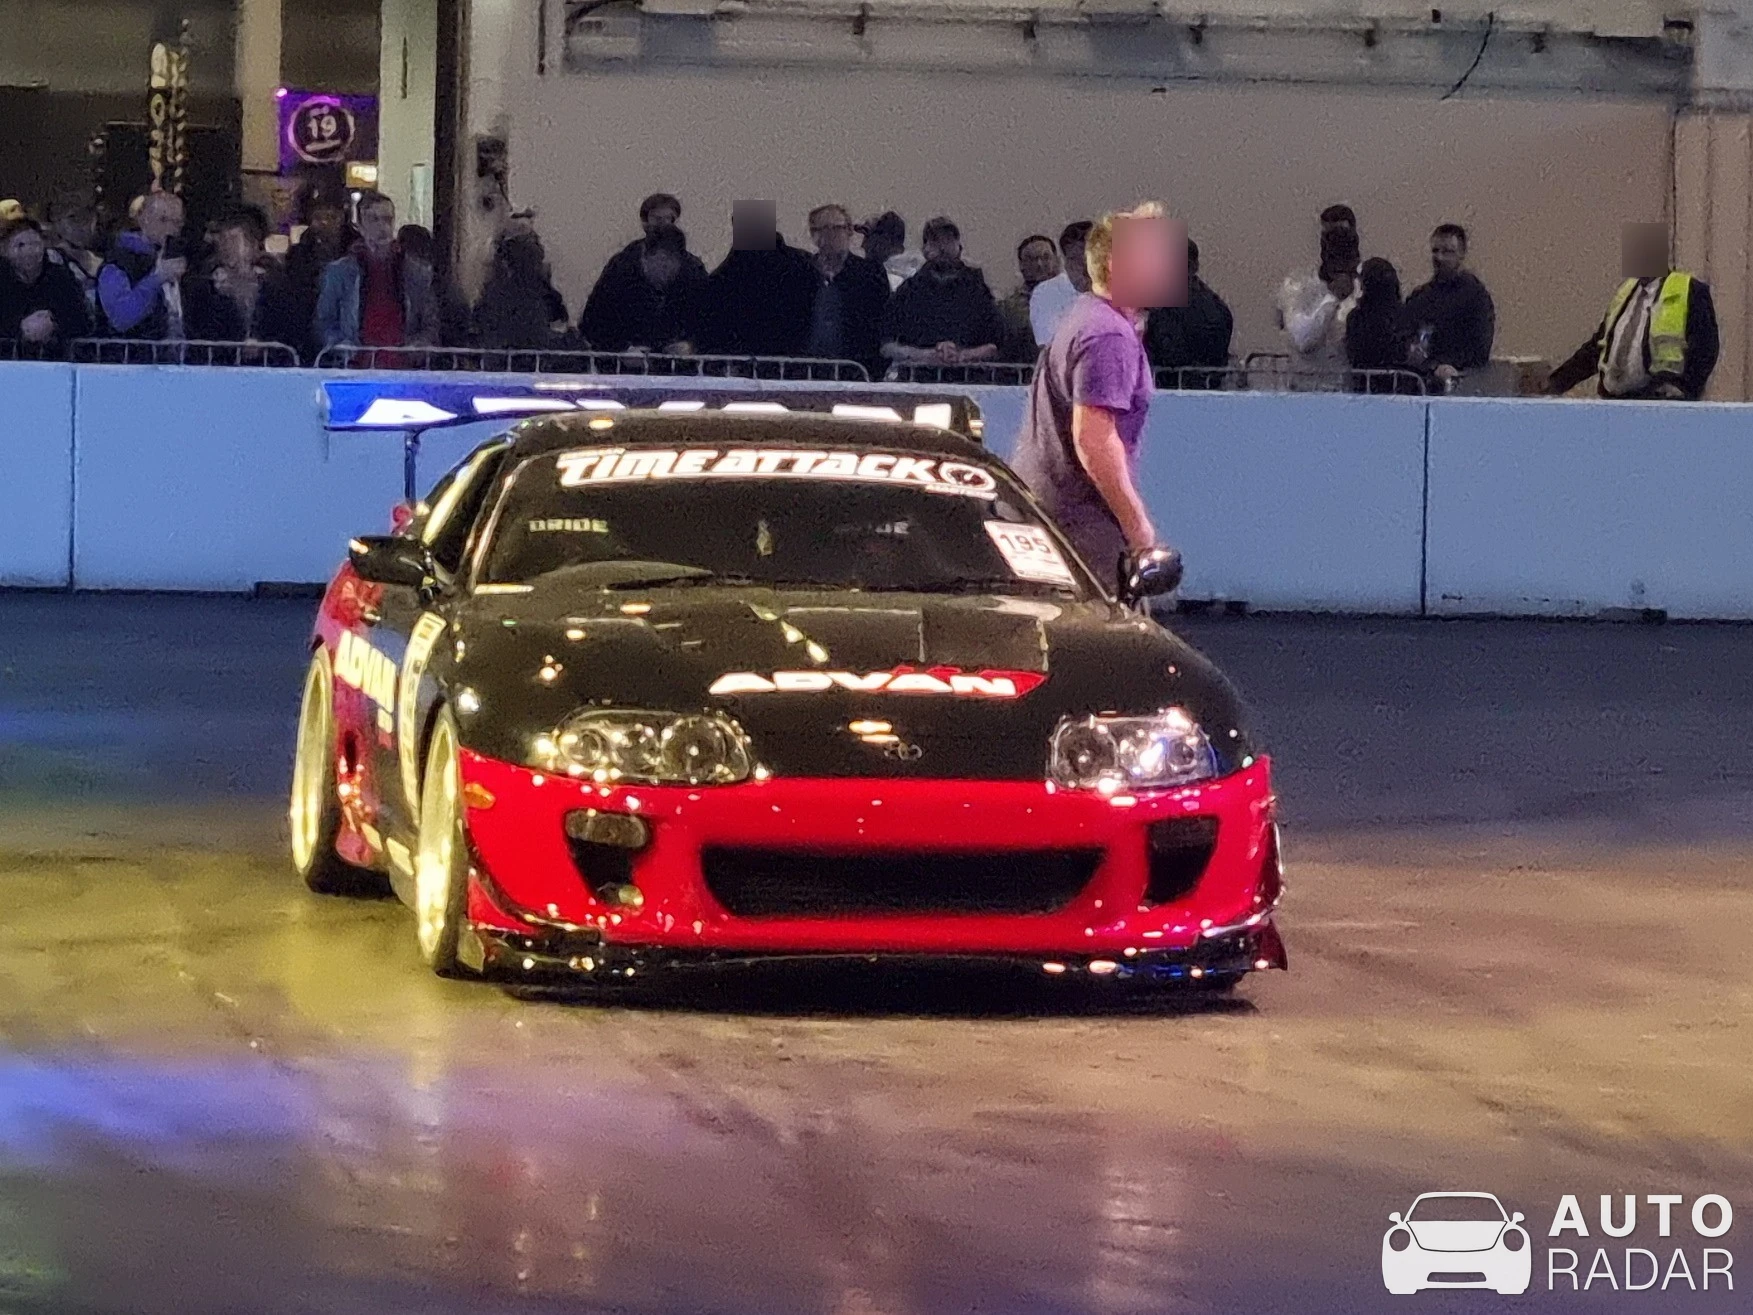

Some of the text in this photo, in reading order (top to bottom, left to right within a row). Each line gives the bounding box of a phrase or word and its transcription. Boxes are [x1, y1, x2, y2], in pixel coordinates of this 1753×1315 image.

[307, 114, 337, 139] 19
[1000, 534, 1051, 555] 195
[708, 671, 1017, 696] ADVAN
